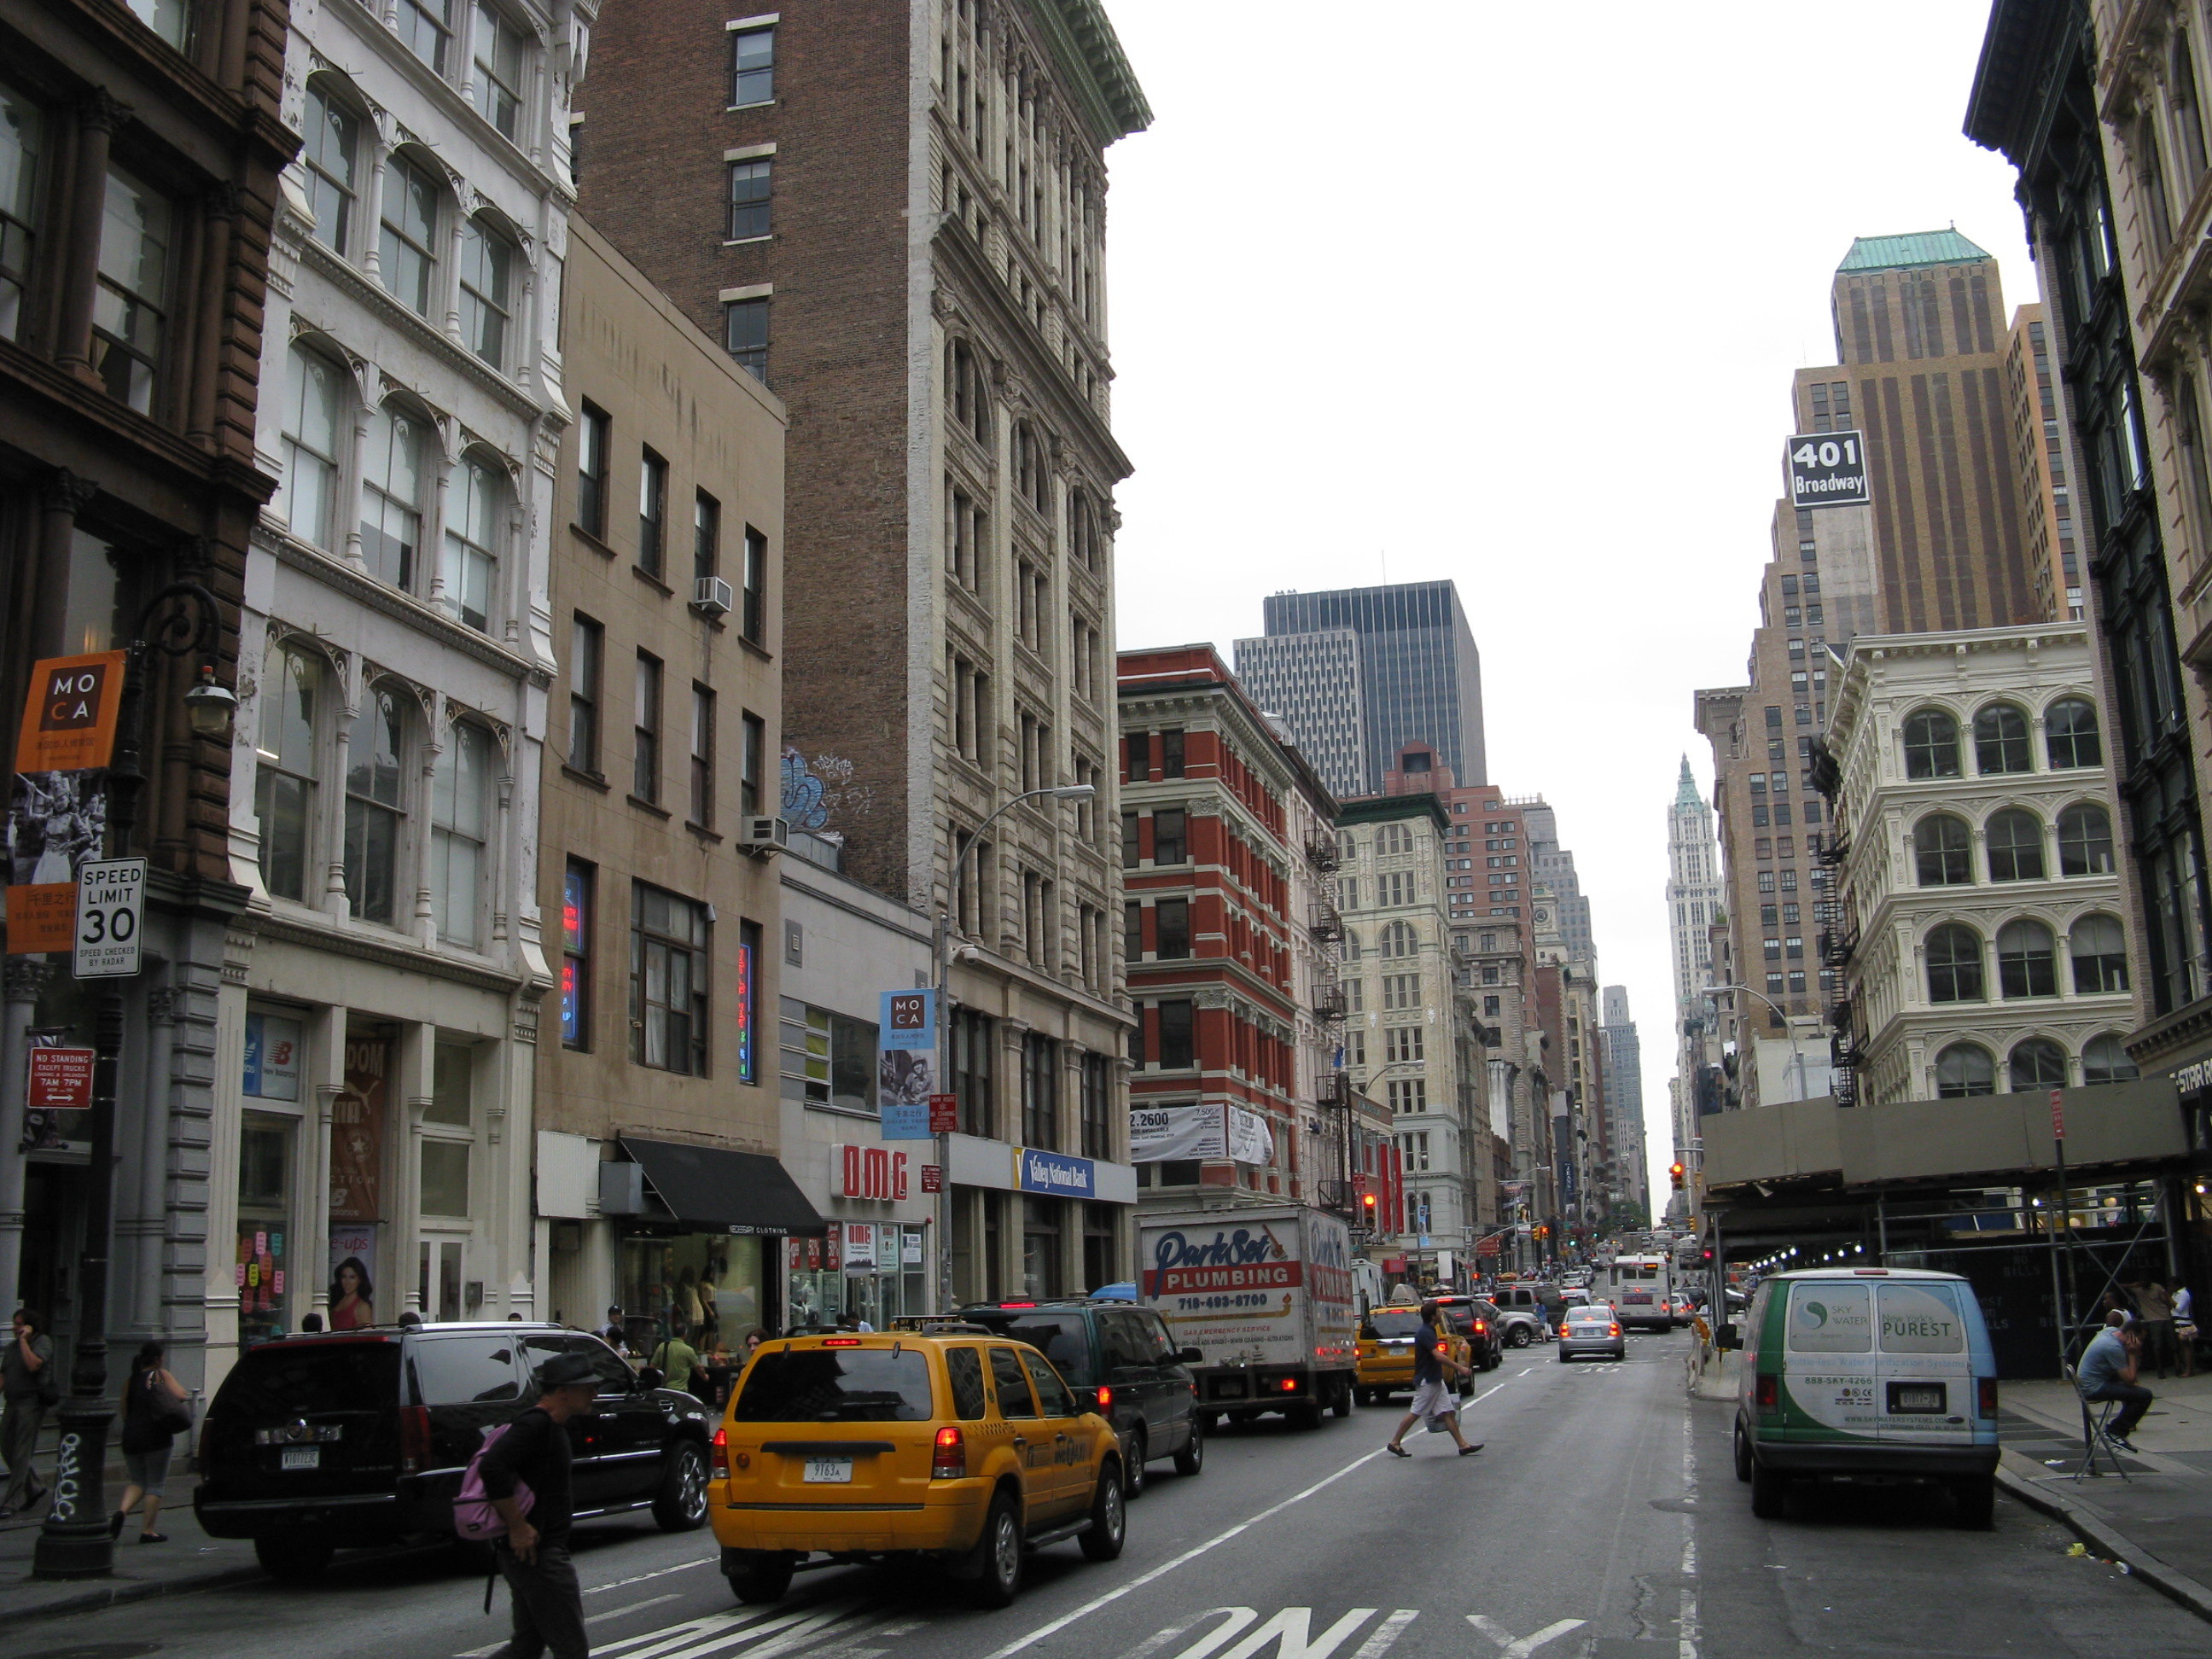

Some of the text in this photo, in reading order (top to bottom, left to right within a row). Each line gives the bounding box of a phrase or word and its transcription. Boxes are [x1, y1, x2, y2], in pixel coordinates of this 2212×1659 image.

[1793, 439, 1856, 469] 401
[1796, 473, 1863, 494] Broadway
[84, 869, 141, 885] SPEED
[88, 888, 133, 904] LIMIT
[83, 907, 135, 944] 30
[79, 946, 135, 958] SPEED CHECKED
[102, 957, 125, 965] RADAR
[51, 1055, 89, 1063] STANDING
[843, 1145, 907, 1201] OMG
[1029, 1155, 1049, 1189] Valley
[1049, 1162, 1072, 1186] National
[1072, 1166, 1088, 1188] Bank
[729, 1225, 754, 1234] NECESSARY
[331, 1237, 369, 1254] e-ups
[1167, 1267, 1288, 1289] PLUMBING
[1834, 1316, 1868, 1325] WATER
[1883, 1313, 1902, 1323] New
[1883, 1323, 1951, 1336] PUREST
[1839, 1358, 1867, 1366] Water
[1929, 1359, 1966, 1369] Systems
